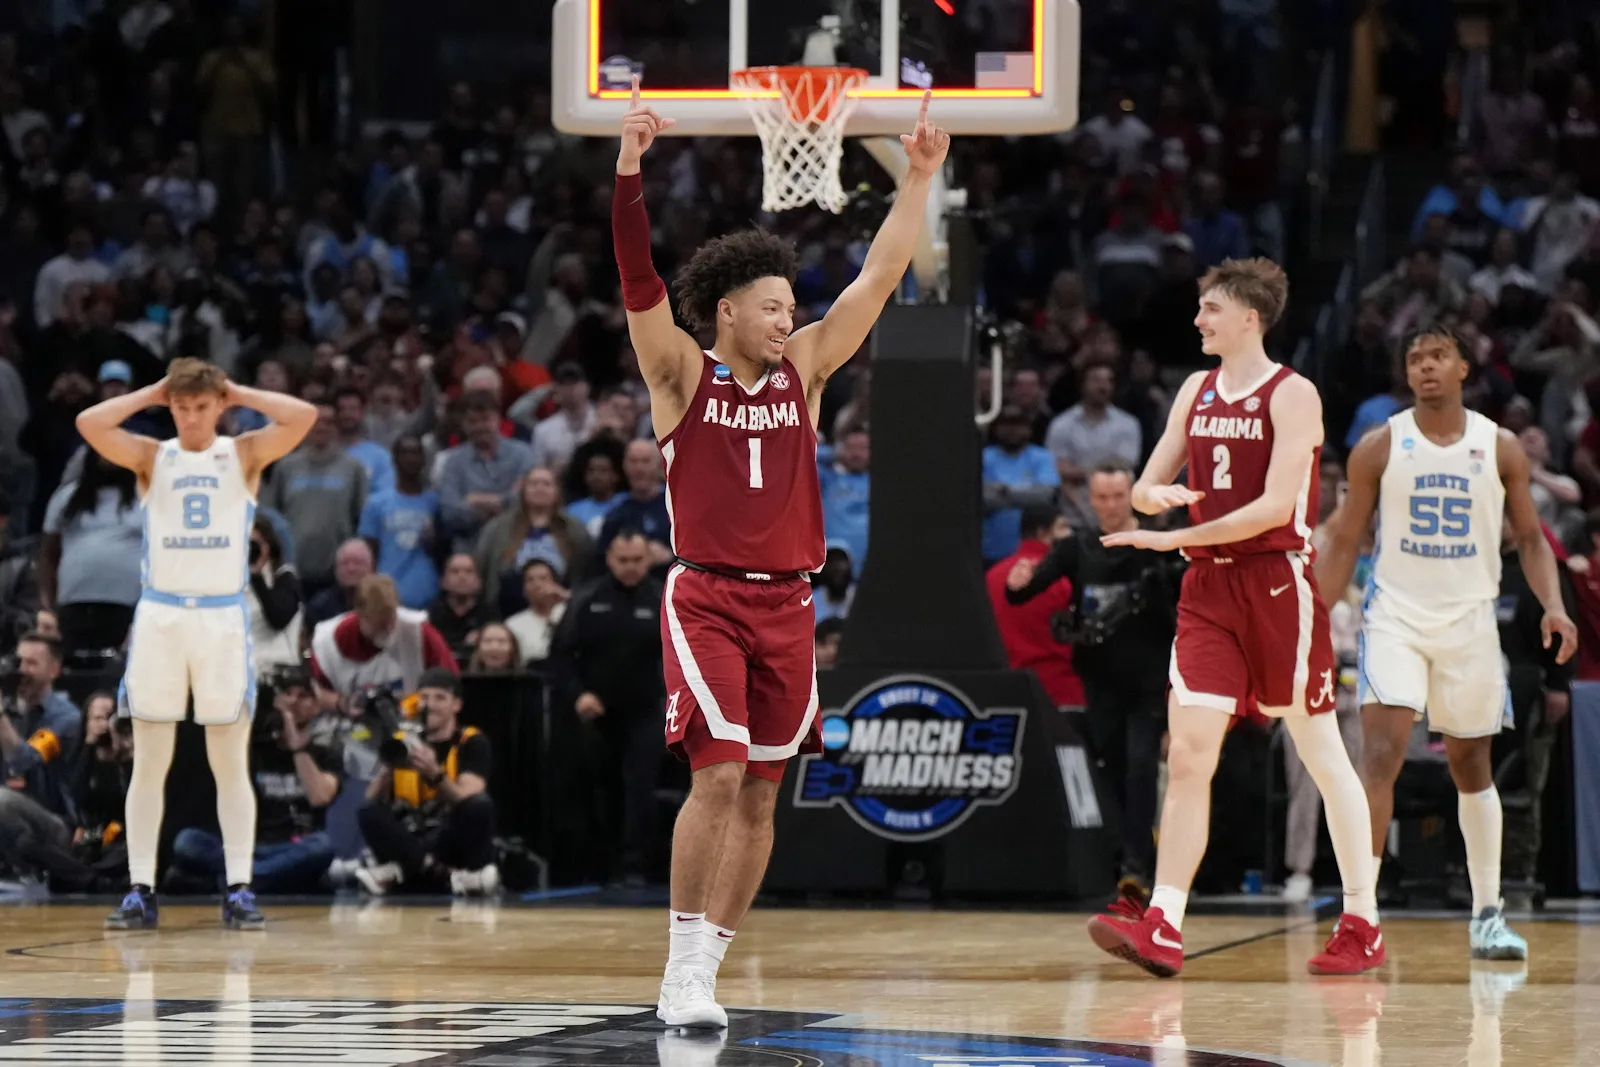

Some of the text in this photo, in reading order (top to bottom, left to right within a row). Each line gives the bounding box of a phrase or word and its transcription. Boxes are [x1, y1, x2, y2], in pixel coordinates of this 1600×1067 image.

[771, 372, 789, 389] SEC
[703, 397, 800, 431] ALABAMA
[1189, 415, 1264, 440] ALABAMA
[747, 437, 763, 489] 1
[1212, 443, 1233, 490] 2
[1415, 473, 1470, 493] NORTH
[183, 493, 210, 528] 8
[1409, 496, 1473, 538] 55
[163, 535, 230, 549] CAROLINA
[1400, 536, 1478, 559] CAROLINA
[850, 718, 964, 753] MARCH
[861, 753, 1015, 789] MADNESS
